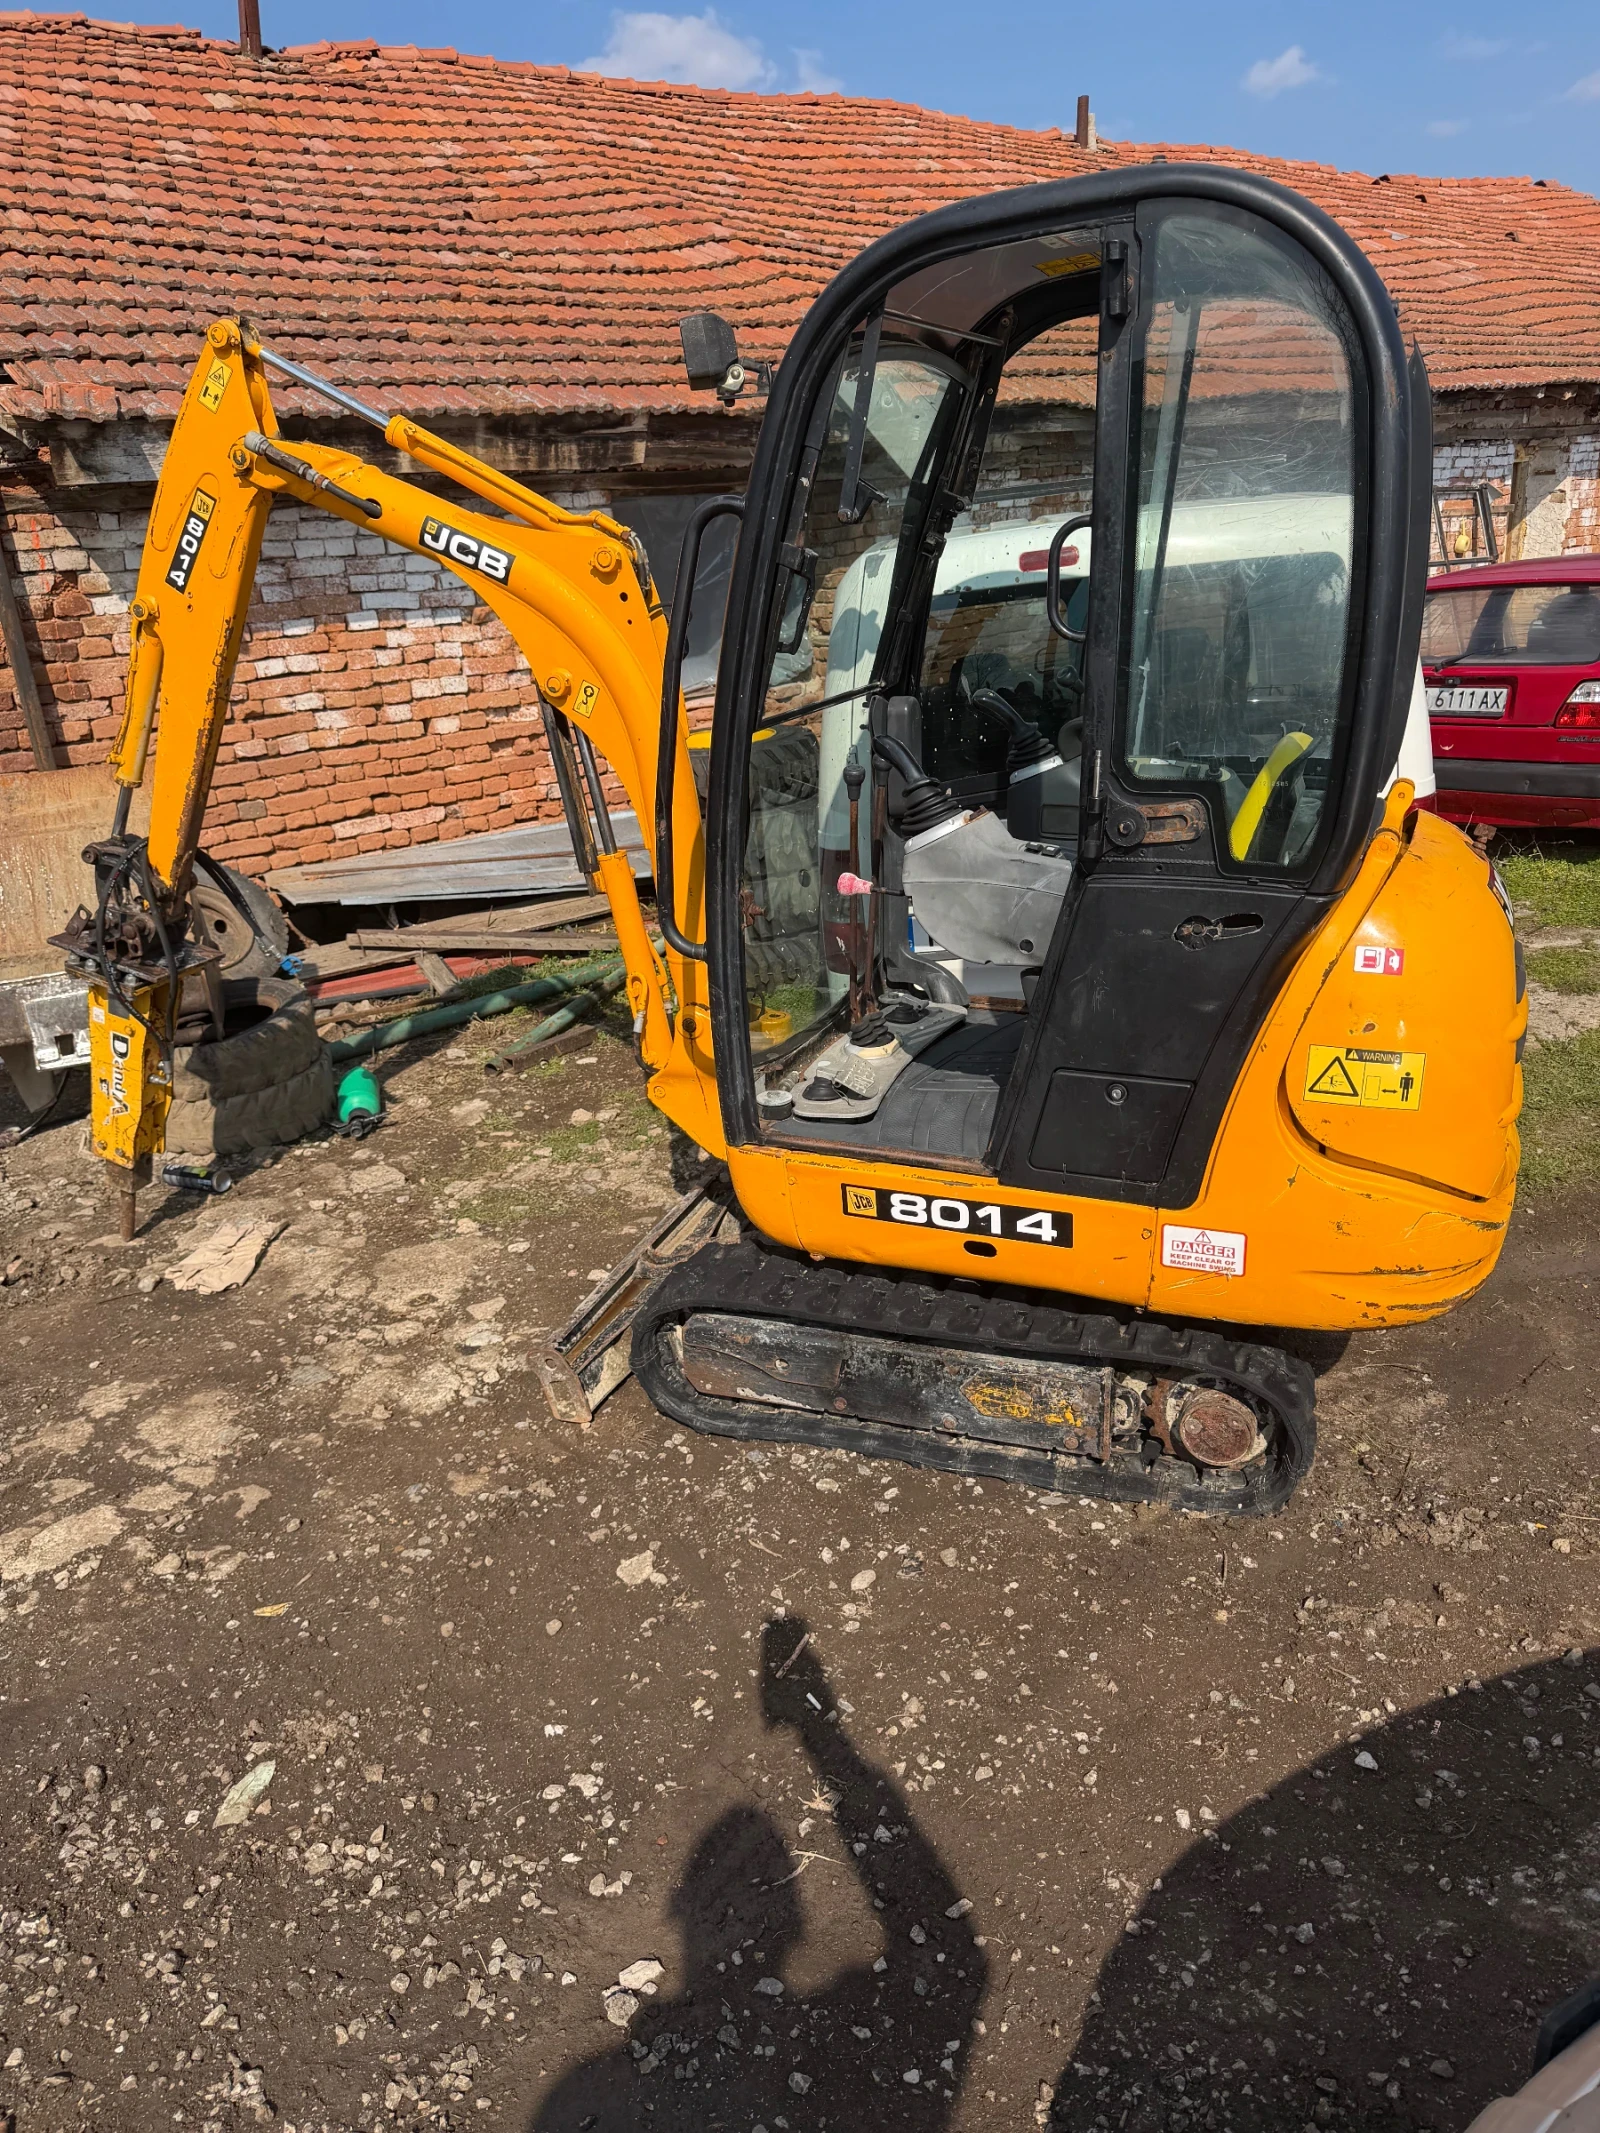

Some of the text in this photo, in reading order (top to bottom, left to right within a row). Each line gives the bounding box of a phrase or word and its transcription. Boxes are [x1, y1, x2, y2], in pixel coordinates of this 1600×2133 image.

[169, 517, 205, 587] 8014
[423, 527, 509, 579] JCB
[1362, 1052, 1401, 1063] WARNING
[852, 1192, 1058, 1243] JCB 8014
[1170, 1252, 1192, 1262] KEEP
[1195, 1255, 1222, 1265] CLEAR
[1173, 1241, 1235, 1259] DANGER
[1169, 1259, 1237, 1273] MACHINE SWING
